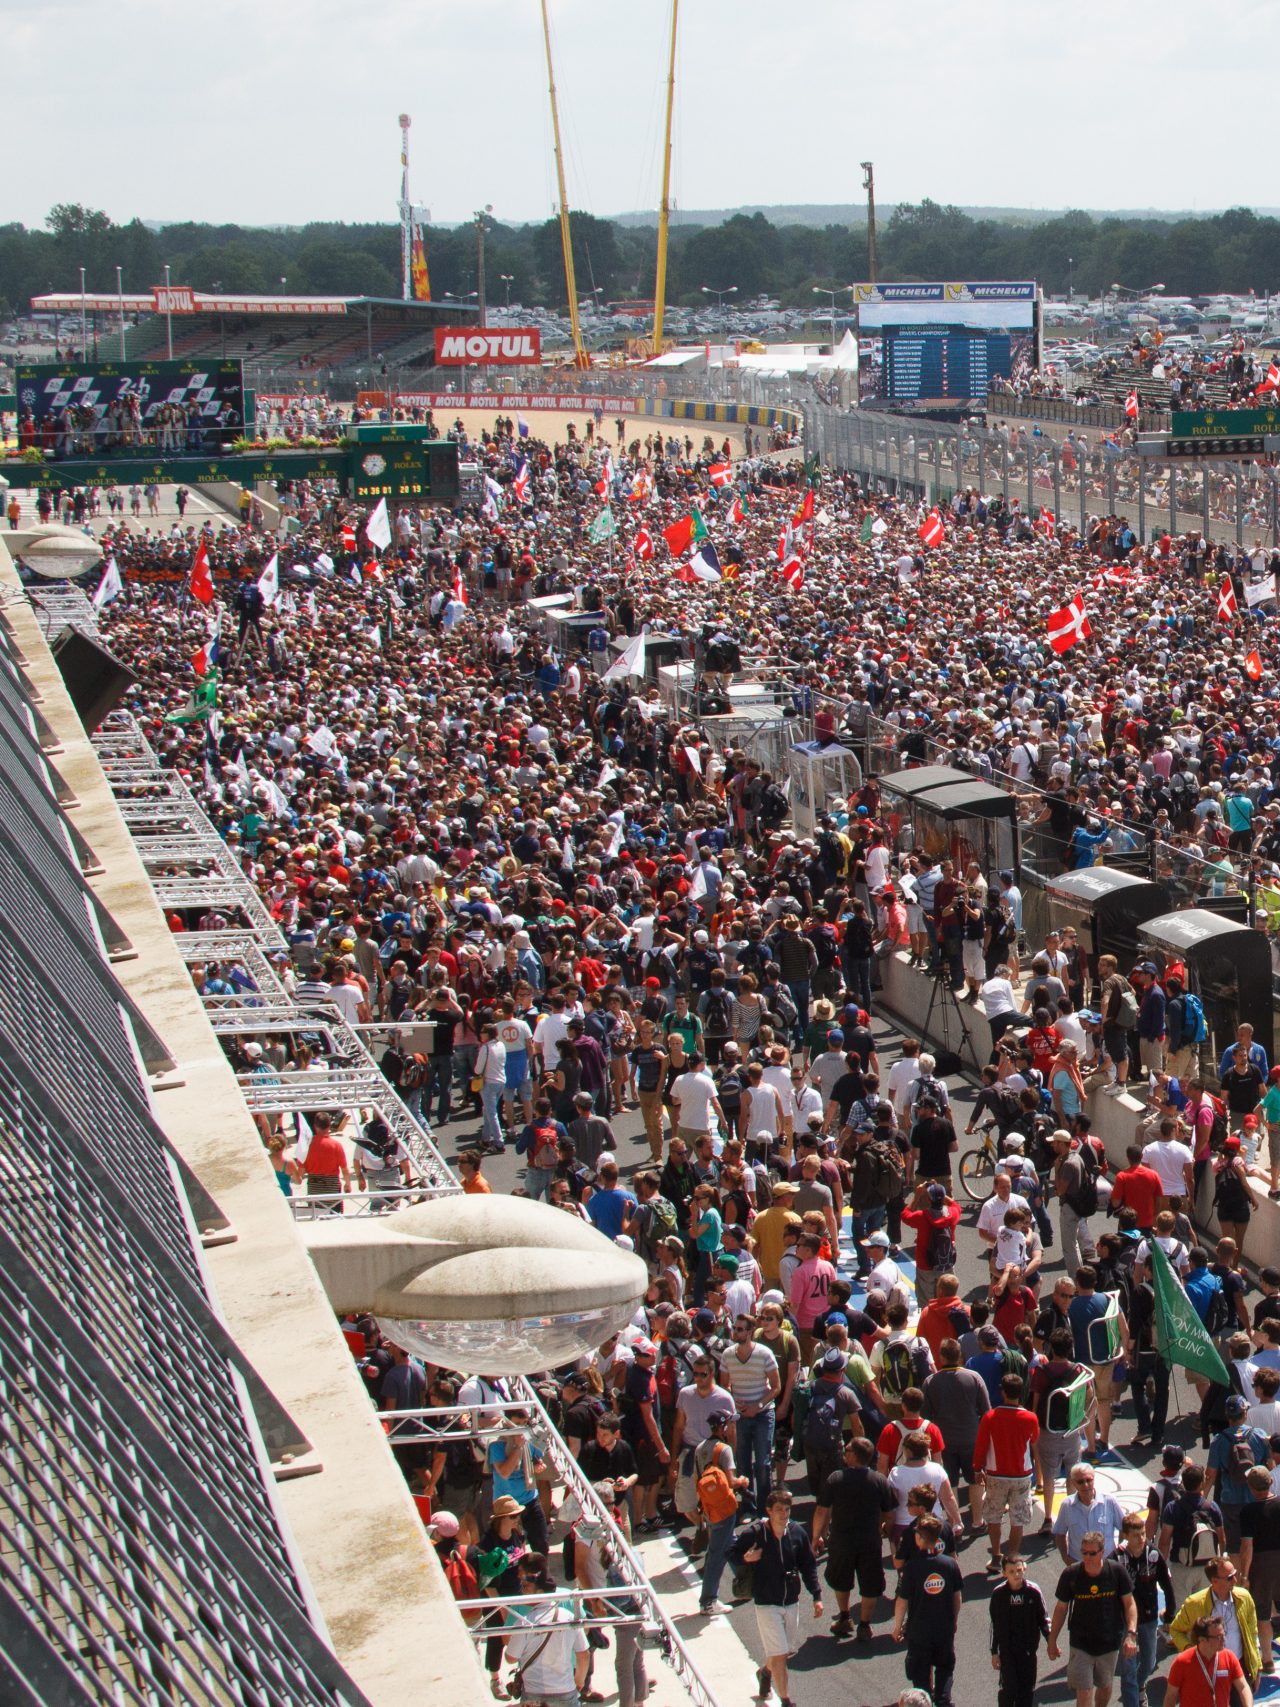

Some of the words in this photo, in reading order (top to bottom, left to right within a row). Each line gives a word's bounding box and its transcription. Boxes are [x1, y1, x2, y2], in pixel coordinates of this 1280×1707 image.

[884, 288, 941, 297] MICHELIN
[974, 287, 1031, 296] MICHELIN
[158, 290, 194, 310] MOTUL
[440, 335, 535, 358] MOTUL
[436, 396, 466, 407] MOTUL
[470, 396, 498, 408] MOTUL
[502, 396, 528, 408] MOTUL
[531, 397, 556, 408] MOTUL
[560, 398, 582, 409] MOTUL
[1192, 426, 1228, 436] ROLEX
[198, 474, 230, 482] ROLEX
[253, 472, 284, 480] ROLEX
[308, 470, 338, 478] ROLEX
[31, 480, 62, 488] ROLEX
[87, 478, 118, 486] ROLEX
[143, 476, 174, 484] ROLEX
[810, 1274, 830, 1298] 20
[1176, 1337, 1206, 1356] CING
[926, 1580, 943, 1588] Gulf
